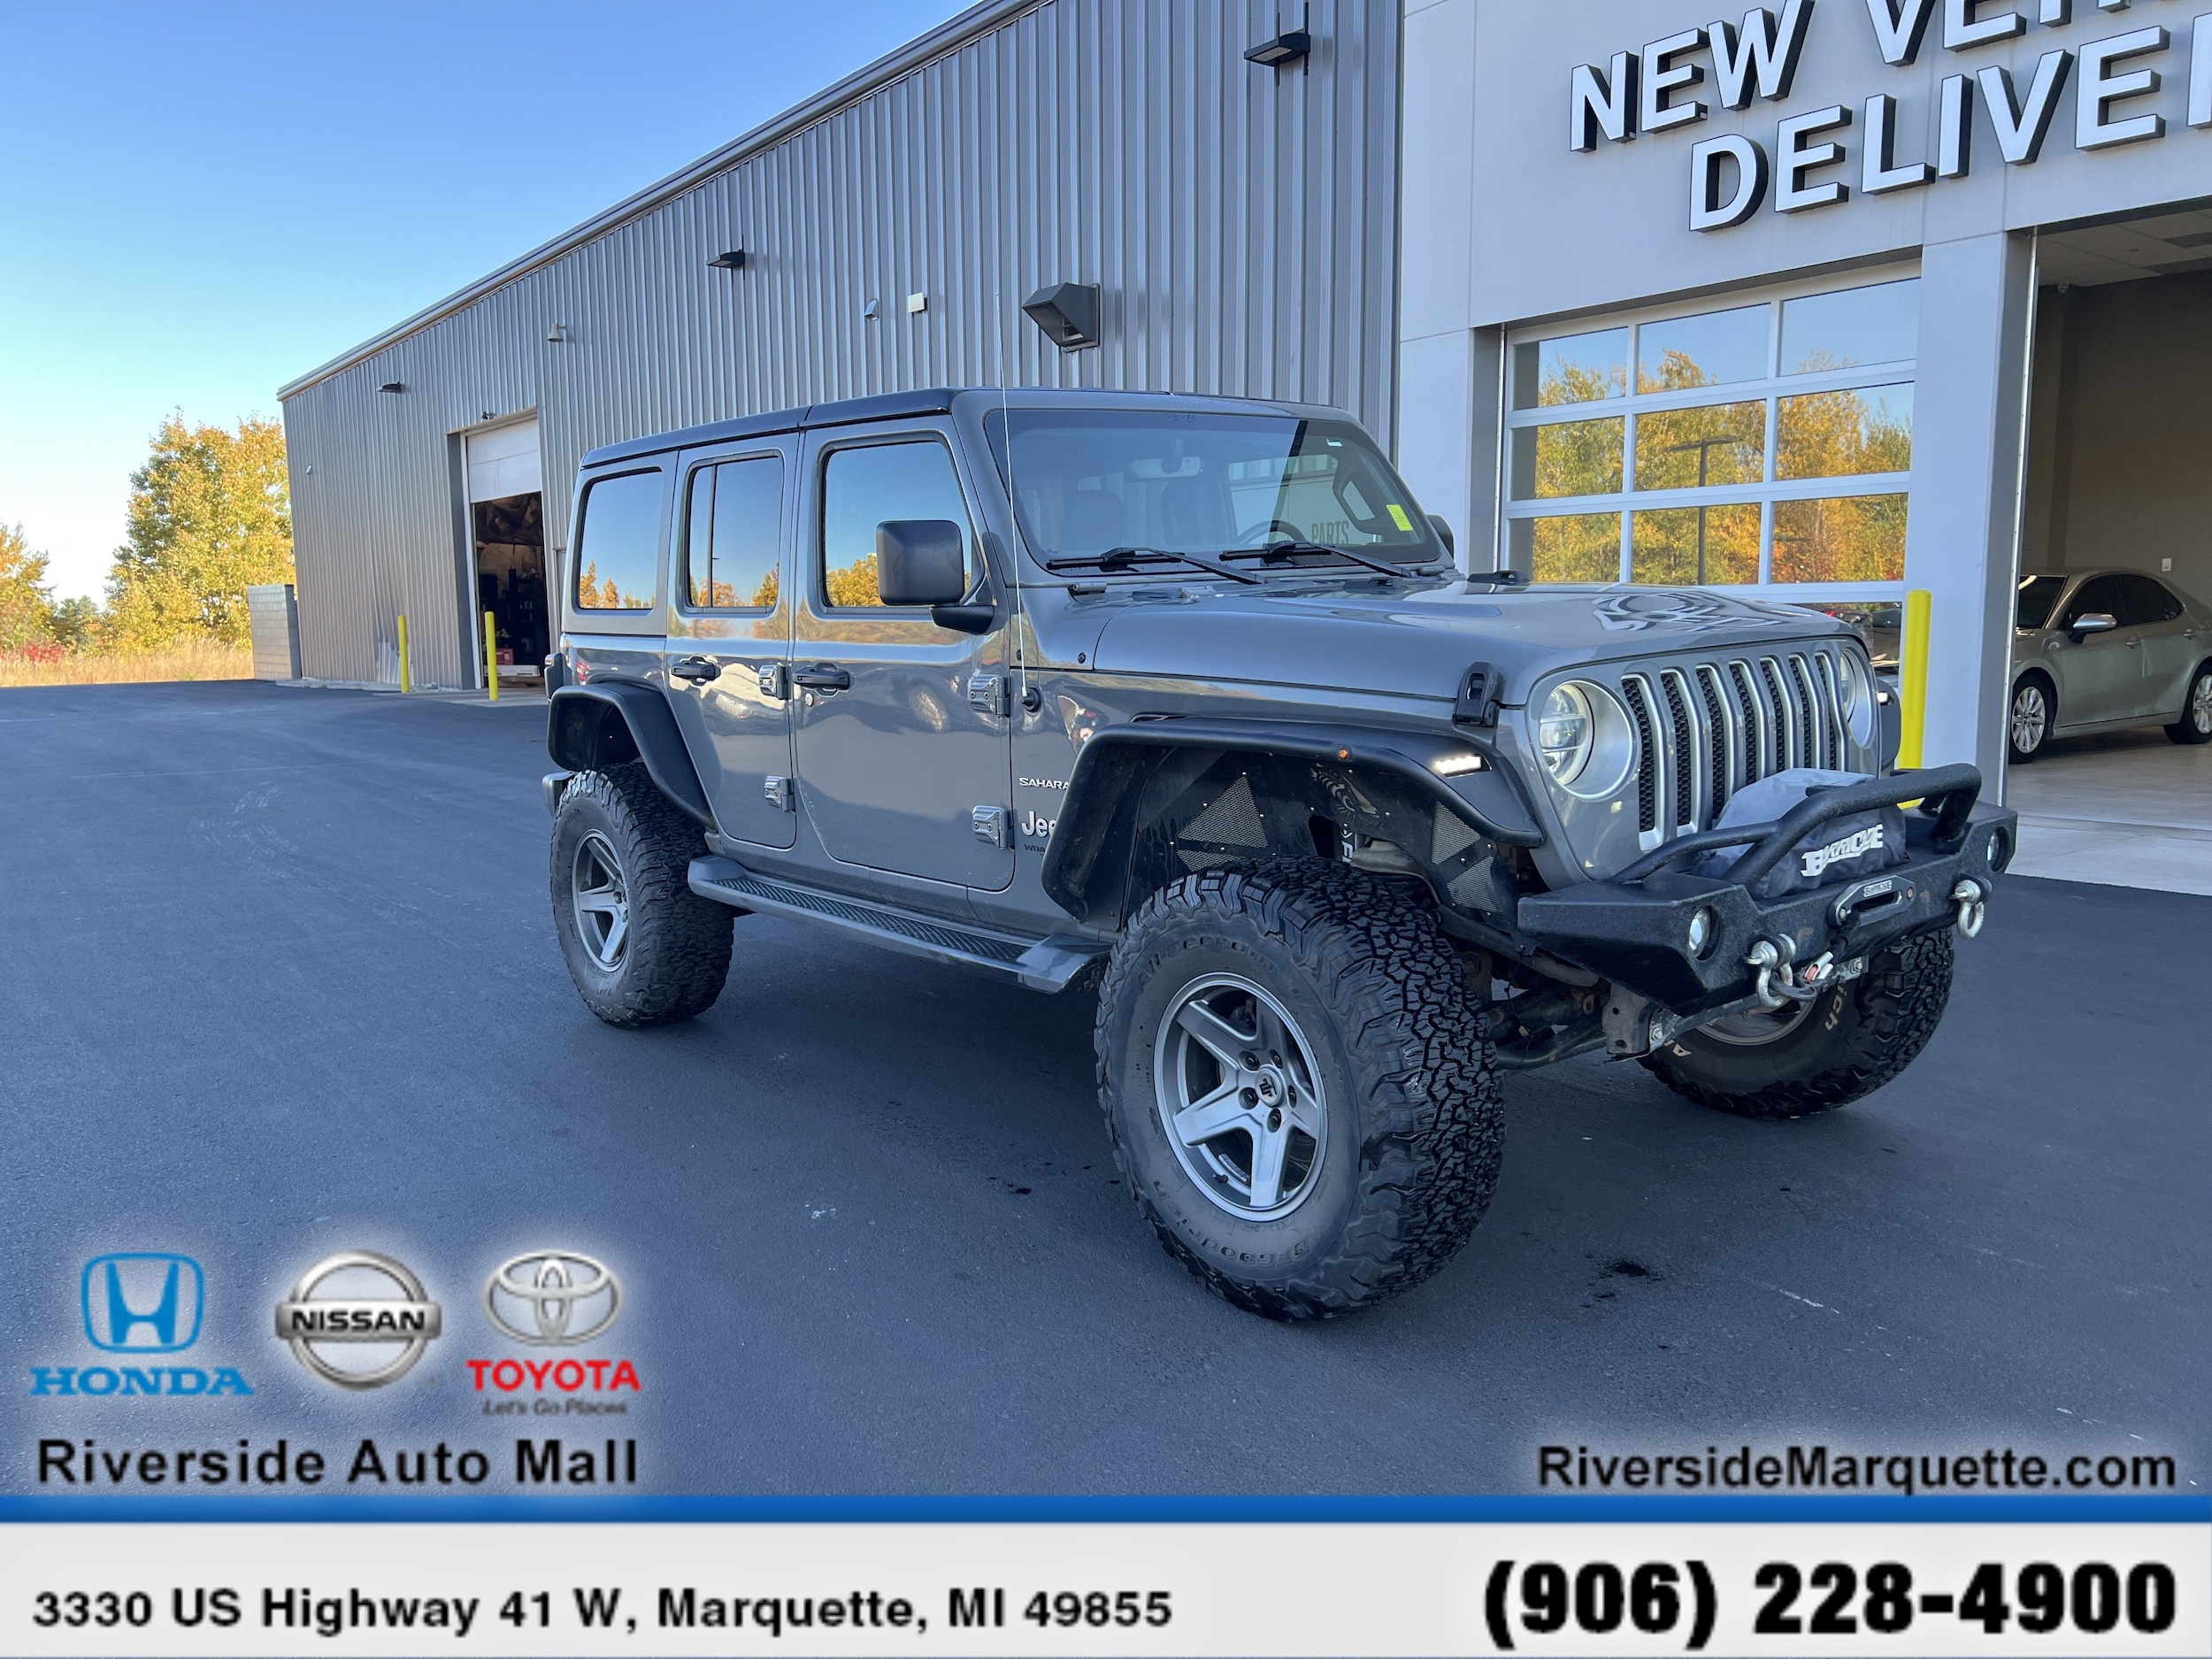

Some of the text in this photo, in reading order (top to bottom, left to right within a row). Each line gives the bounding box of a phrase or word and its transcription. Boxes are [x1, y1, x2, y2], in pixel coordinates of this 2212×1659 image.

[1570, 0, 1815, 152] NEW
[1688, 13, 2212, 232] DELIVE
[1311, 519, 1349, 545] PARTS
[1018, 777, 1069, 790] SAHARA
